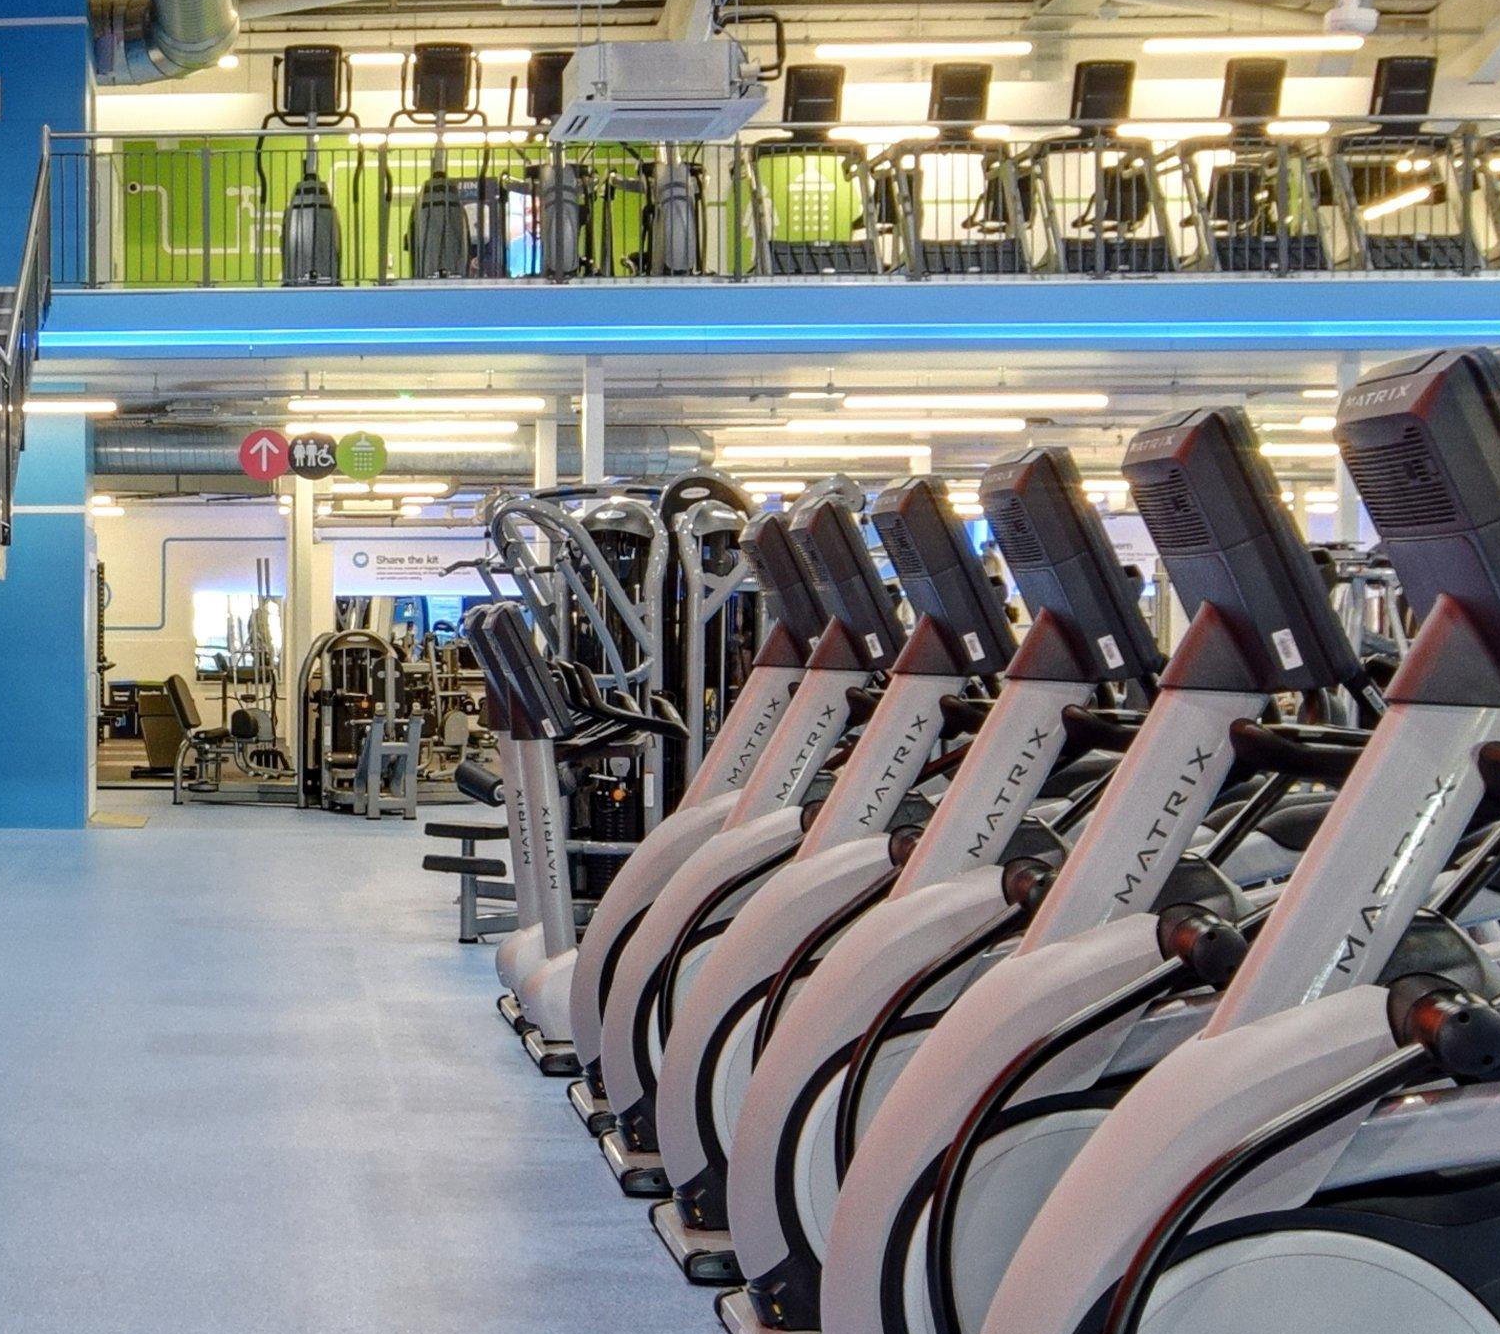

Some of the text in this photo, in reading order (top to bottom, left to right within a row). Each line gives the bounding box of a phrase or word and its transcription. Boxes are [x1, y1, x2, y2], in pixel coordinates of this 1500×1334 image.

[1346, 382, 1413, 408] MATRIX
[376, 555, 439, 565] Share the kit
[727, 698, 780, 785] MATRIX
[776, 704, 836, 801] MATRIX
[859, 715, 928, 826] MATRIX
[516, 789, 531, 865] MATRIX
[968, 728, 1048, 858] MATRIX
[1114, 747, 1213, 904] MATRIX
[542, 807, 558, 889] MATRIX
